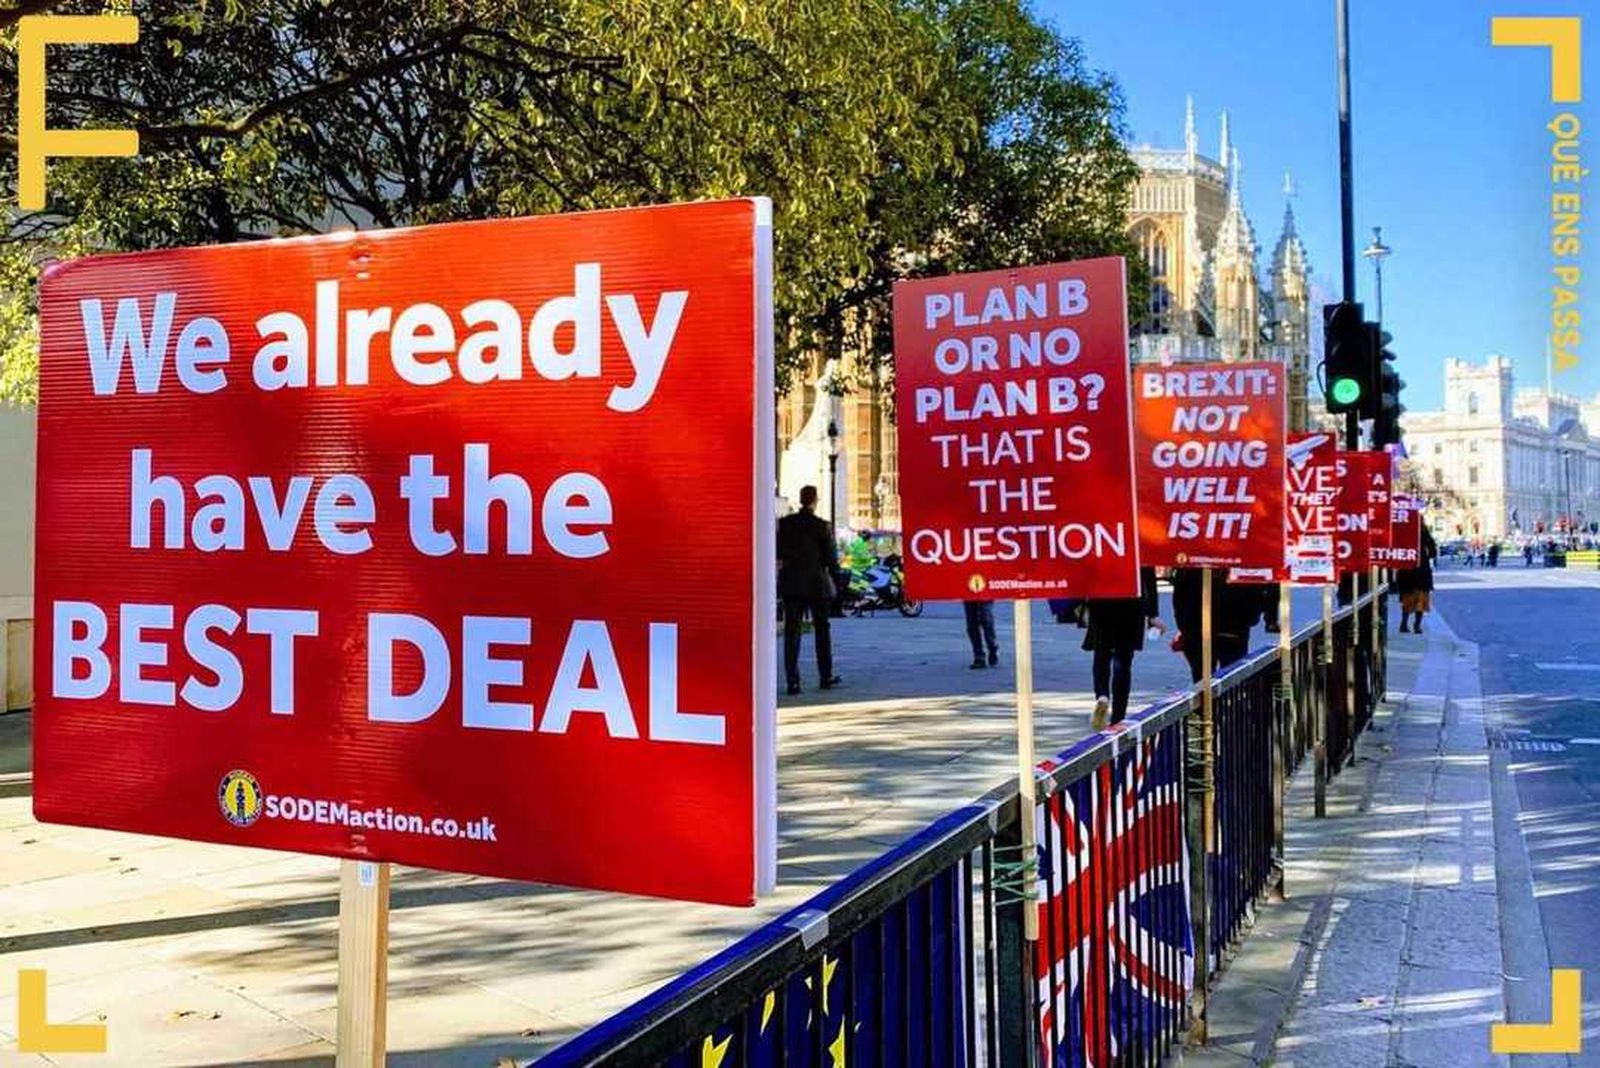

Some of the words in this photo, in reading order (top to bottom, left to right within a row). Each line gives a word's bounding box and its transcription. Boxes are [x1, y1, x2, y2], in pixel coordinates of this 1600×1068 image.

[924, 282, 1047, 329] PLAN
[1057, 279, 1089, 316] B
[80, 292, 231, 396] We
[252, 262, 690, 413] already
[934, 335, 999, 375] OR
[1009, 328, 1080, 368] NO
[915, 379, 1037, 423] PLAN
[1049, 373, 1105, 414] B?
[1143, 368, 1277, 399] BREXIT:
[1171, 405, 1249, 433] NOT
[931, 429, 1044, 468] THAT
[1055, 425, 1091, 462] IS
[1152, 440, 1268, 468] GOING
[130, 448, 376, 555] have
[400, 443, 613, 558] the
[969, 476, 1056, 514] THE
[1163, 476, 1256, 504] WELL
[1290, 492, 1337, 506] THEY
[910, 522, 1126, 565] QUESTION
[1168, 511, 1200, 539] IS
[1205, 512, 1252, 539] IT!
[52, 600, 319, 715] BEST
[367, 612, 726, 745] DEAL
[265, 795, 497, 842] SODEMaction.co.uk
